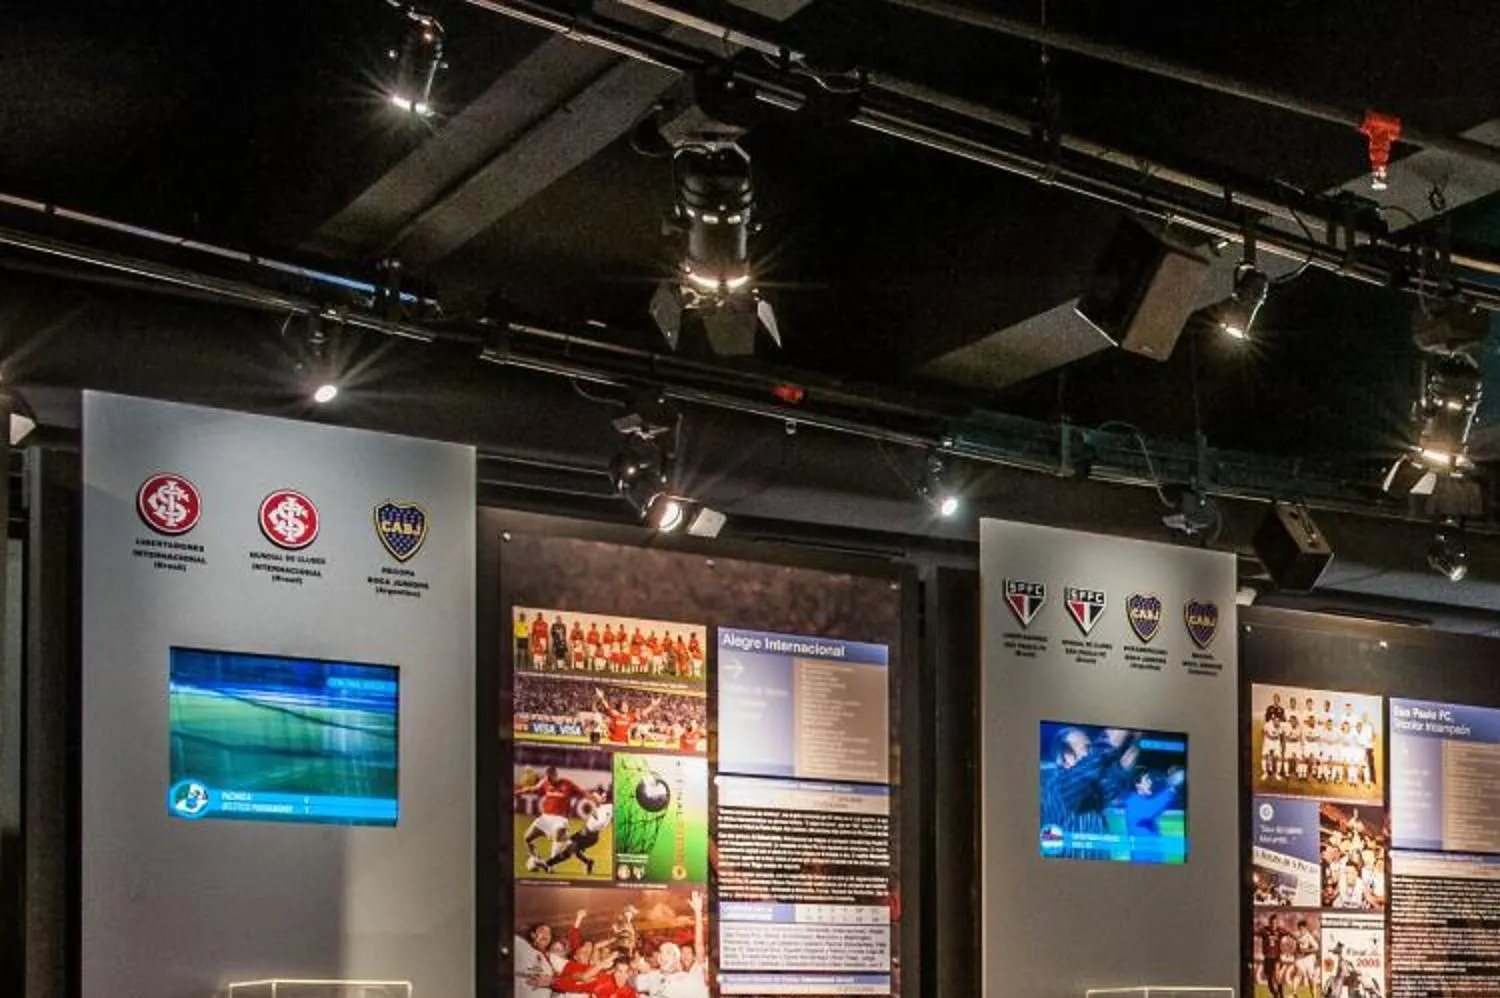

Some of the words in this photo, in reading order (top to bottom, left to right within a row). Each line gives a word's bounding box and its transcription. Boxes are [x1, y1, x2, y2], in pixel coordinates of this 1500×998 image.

[381, 521, 421, 536] CABJ
[722, 632, 762, 651] Alegre
[765, 637, 846, 657] Internacional
